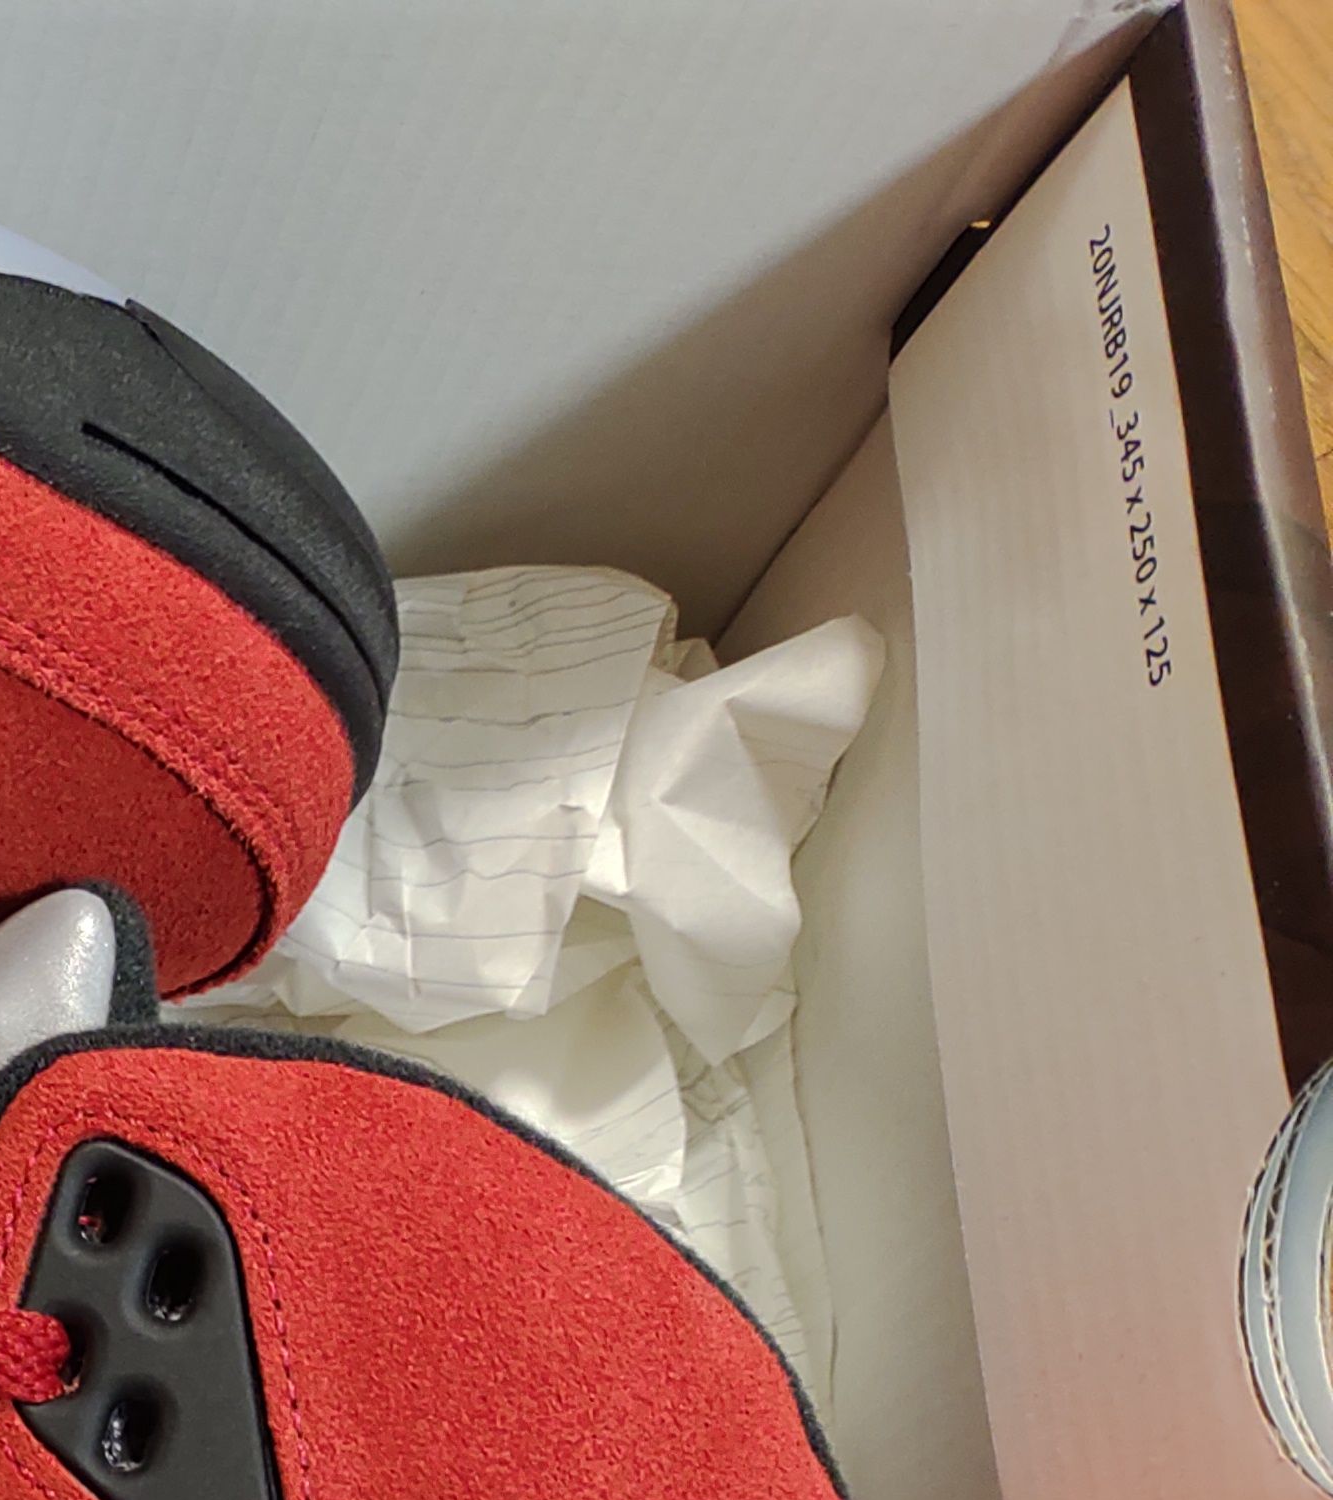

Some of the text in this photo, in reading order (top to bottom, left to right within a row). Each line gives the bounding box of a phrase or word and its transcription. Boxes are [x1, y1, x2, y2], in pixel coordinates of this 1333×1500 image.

[1125, 485, 1144, 516] x
[1128, 511, 1158, 585] 250
[1138, 585, 1157, 617] x
[1143, 615, 1172, 688] 125
